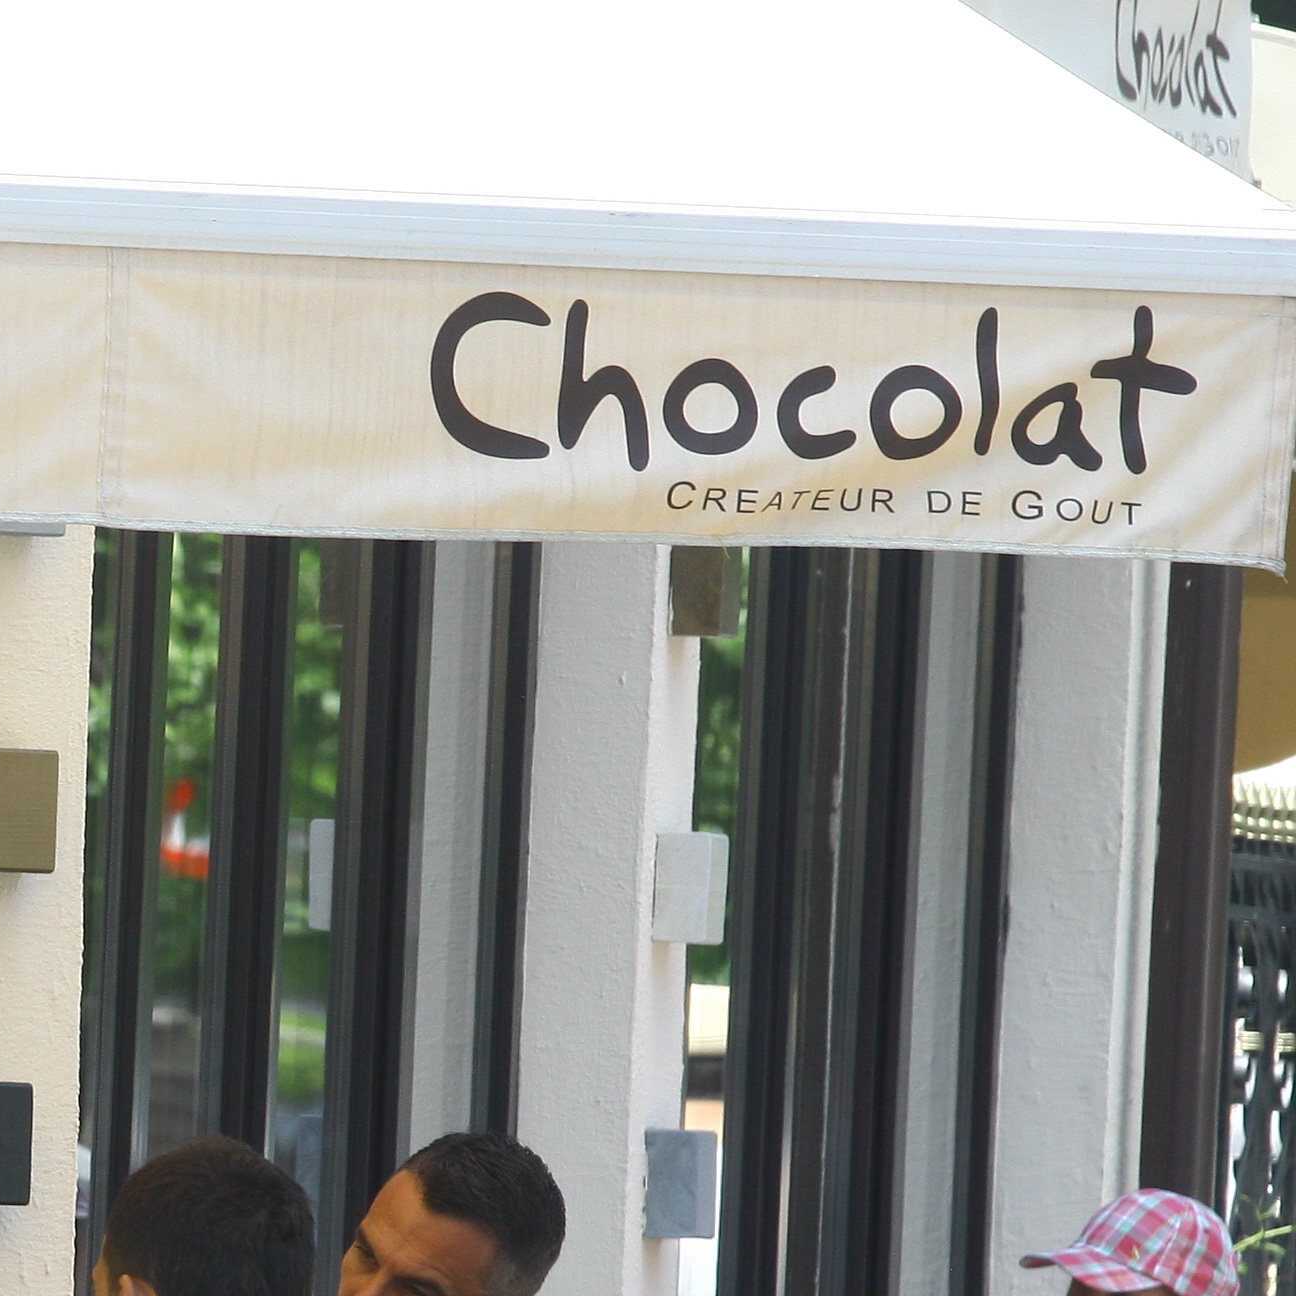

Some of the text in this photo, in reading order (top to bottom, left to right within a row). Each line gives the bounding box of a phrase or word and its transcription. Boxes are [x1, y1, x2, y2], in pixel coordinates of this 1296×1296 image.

[429, 291, 1198, 475] Chocolat
[665, 480, 1144, 527] CREATEUR DE GOUT
